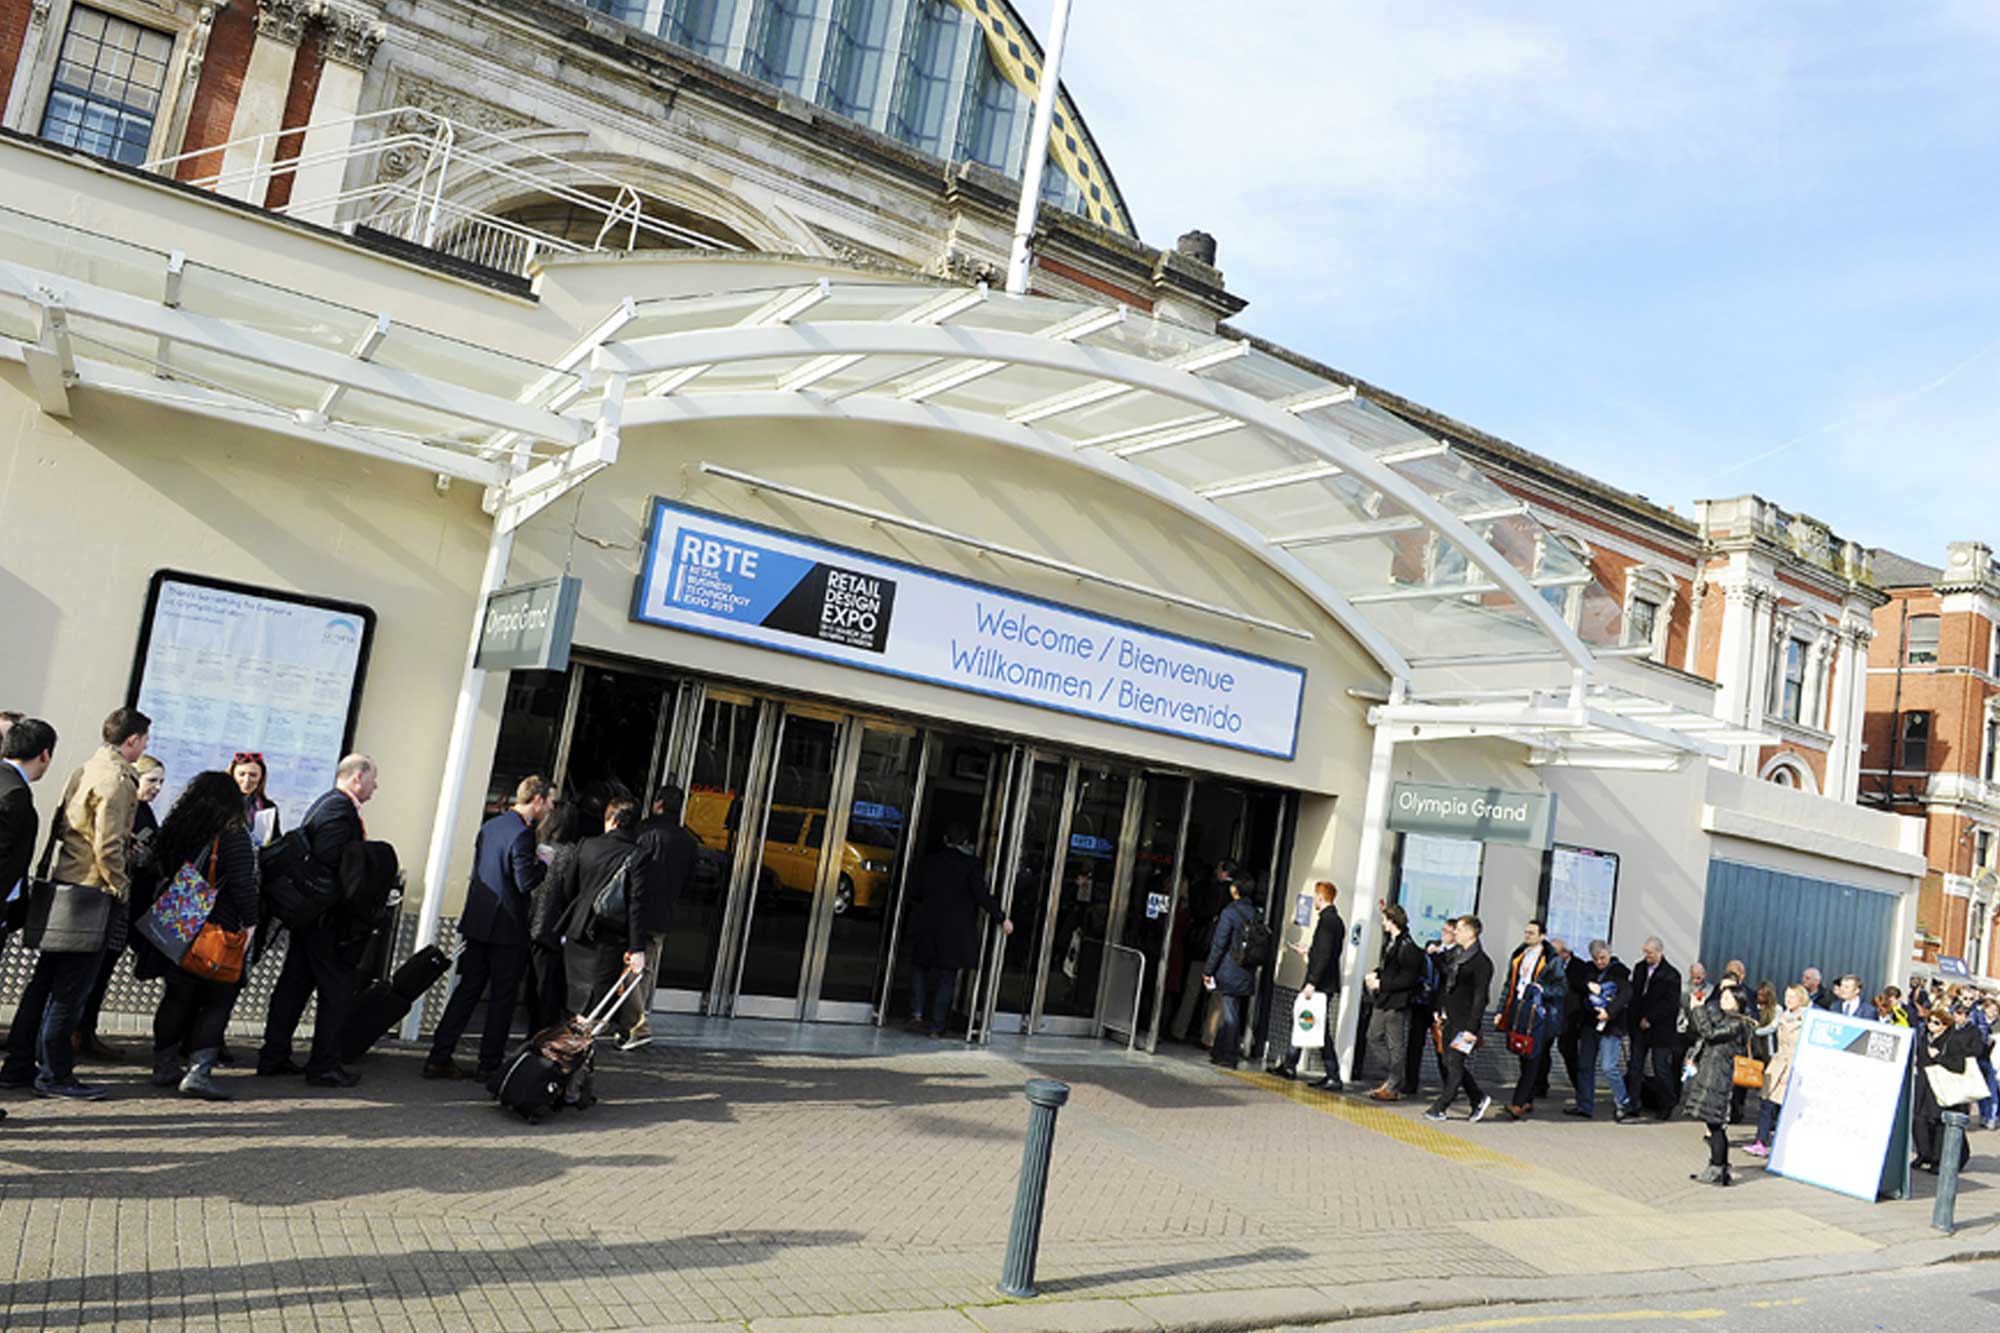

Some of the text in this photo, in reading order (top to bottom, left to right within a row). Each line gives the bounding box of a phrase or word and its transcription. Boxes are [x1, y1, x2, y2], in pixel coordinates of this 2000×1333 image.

[681, 535, 759, 579] RBTE
[828, 570, 881, 600] RETAIL
[684, 595, 709, 608] EXPO
[825, 588, 881, 614] DESIGN
[821, 603, 877, 632] EXPO
[975, 602, 1094, 660] Welcome
[1118, 639, 1234, 693] Bienvenue
[951, 640, 1093, 701] Willkommen
[1118, 680, 1242, 734] Bienvenido
[1398, 791, 1529, 822] Olympia Grand
